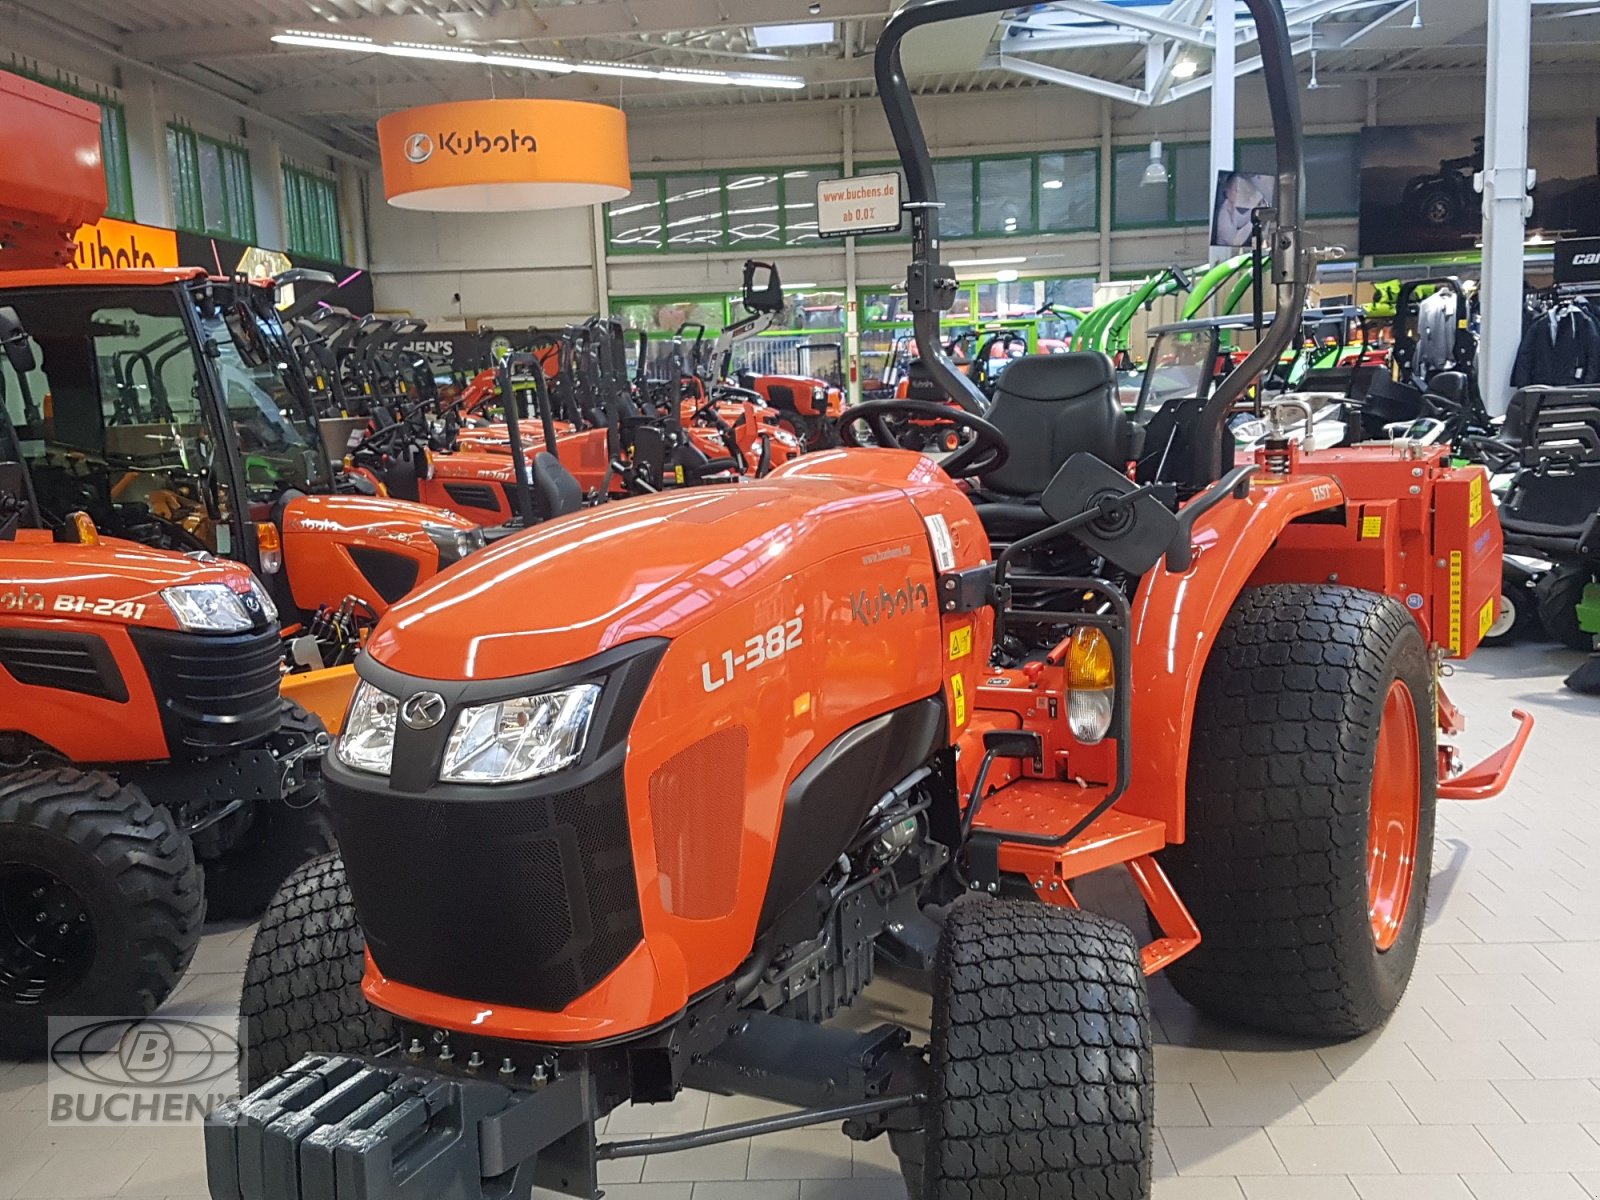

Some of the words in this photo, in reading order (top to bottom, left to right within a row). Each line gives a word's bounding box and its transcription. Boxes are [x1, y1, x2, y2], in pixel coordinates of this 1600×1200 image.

[439, 129, 536, 154] Kubota
[823, 184, 894, 202] www.buchens.de
[843, 210, 853, 222] ab
[1311, 484, 1331, 502] HST
[53, 595, 146, 620] B1-241
[850, 577, 929, 625] Kubota
[701, 617, 803, 692] L1-382
